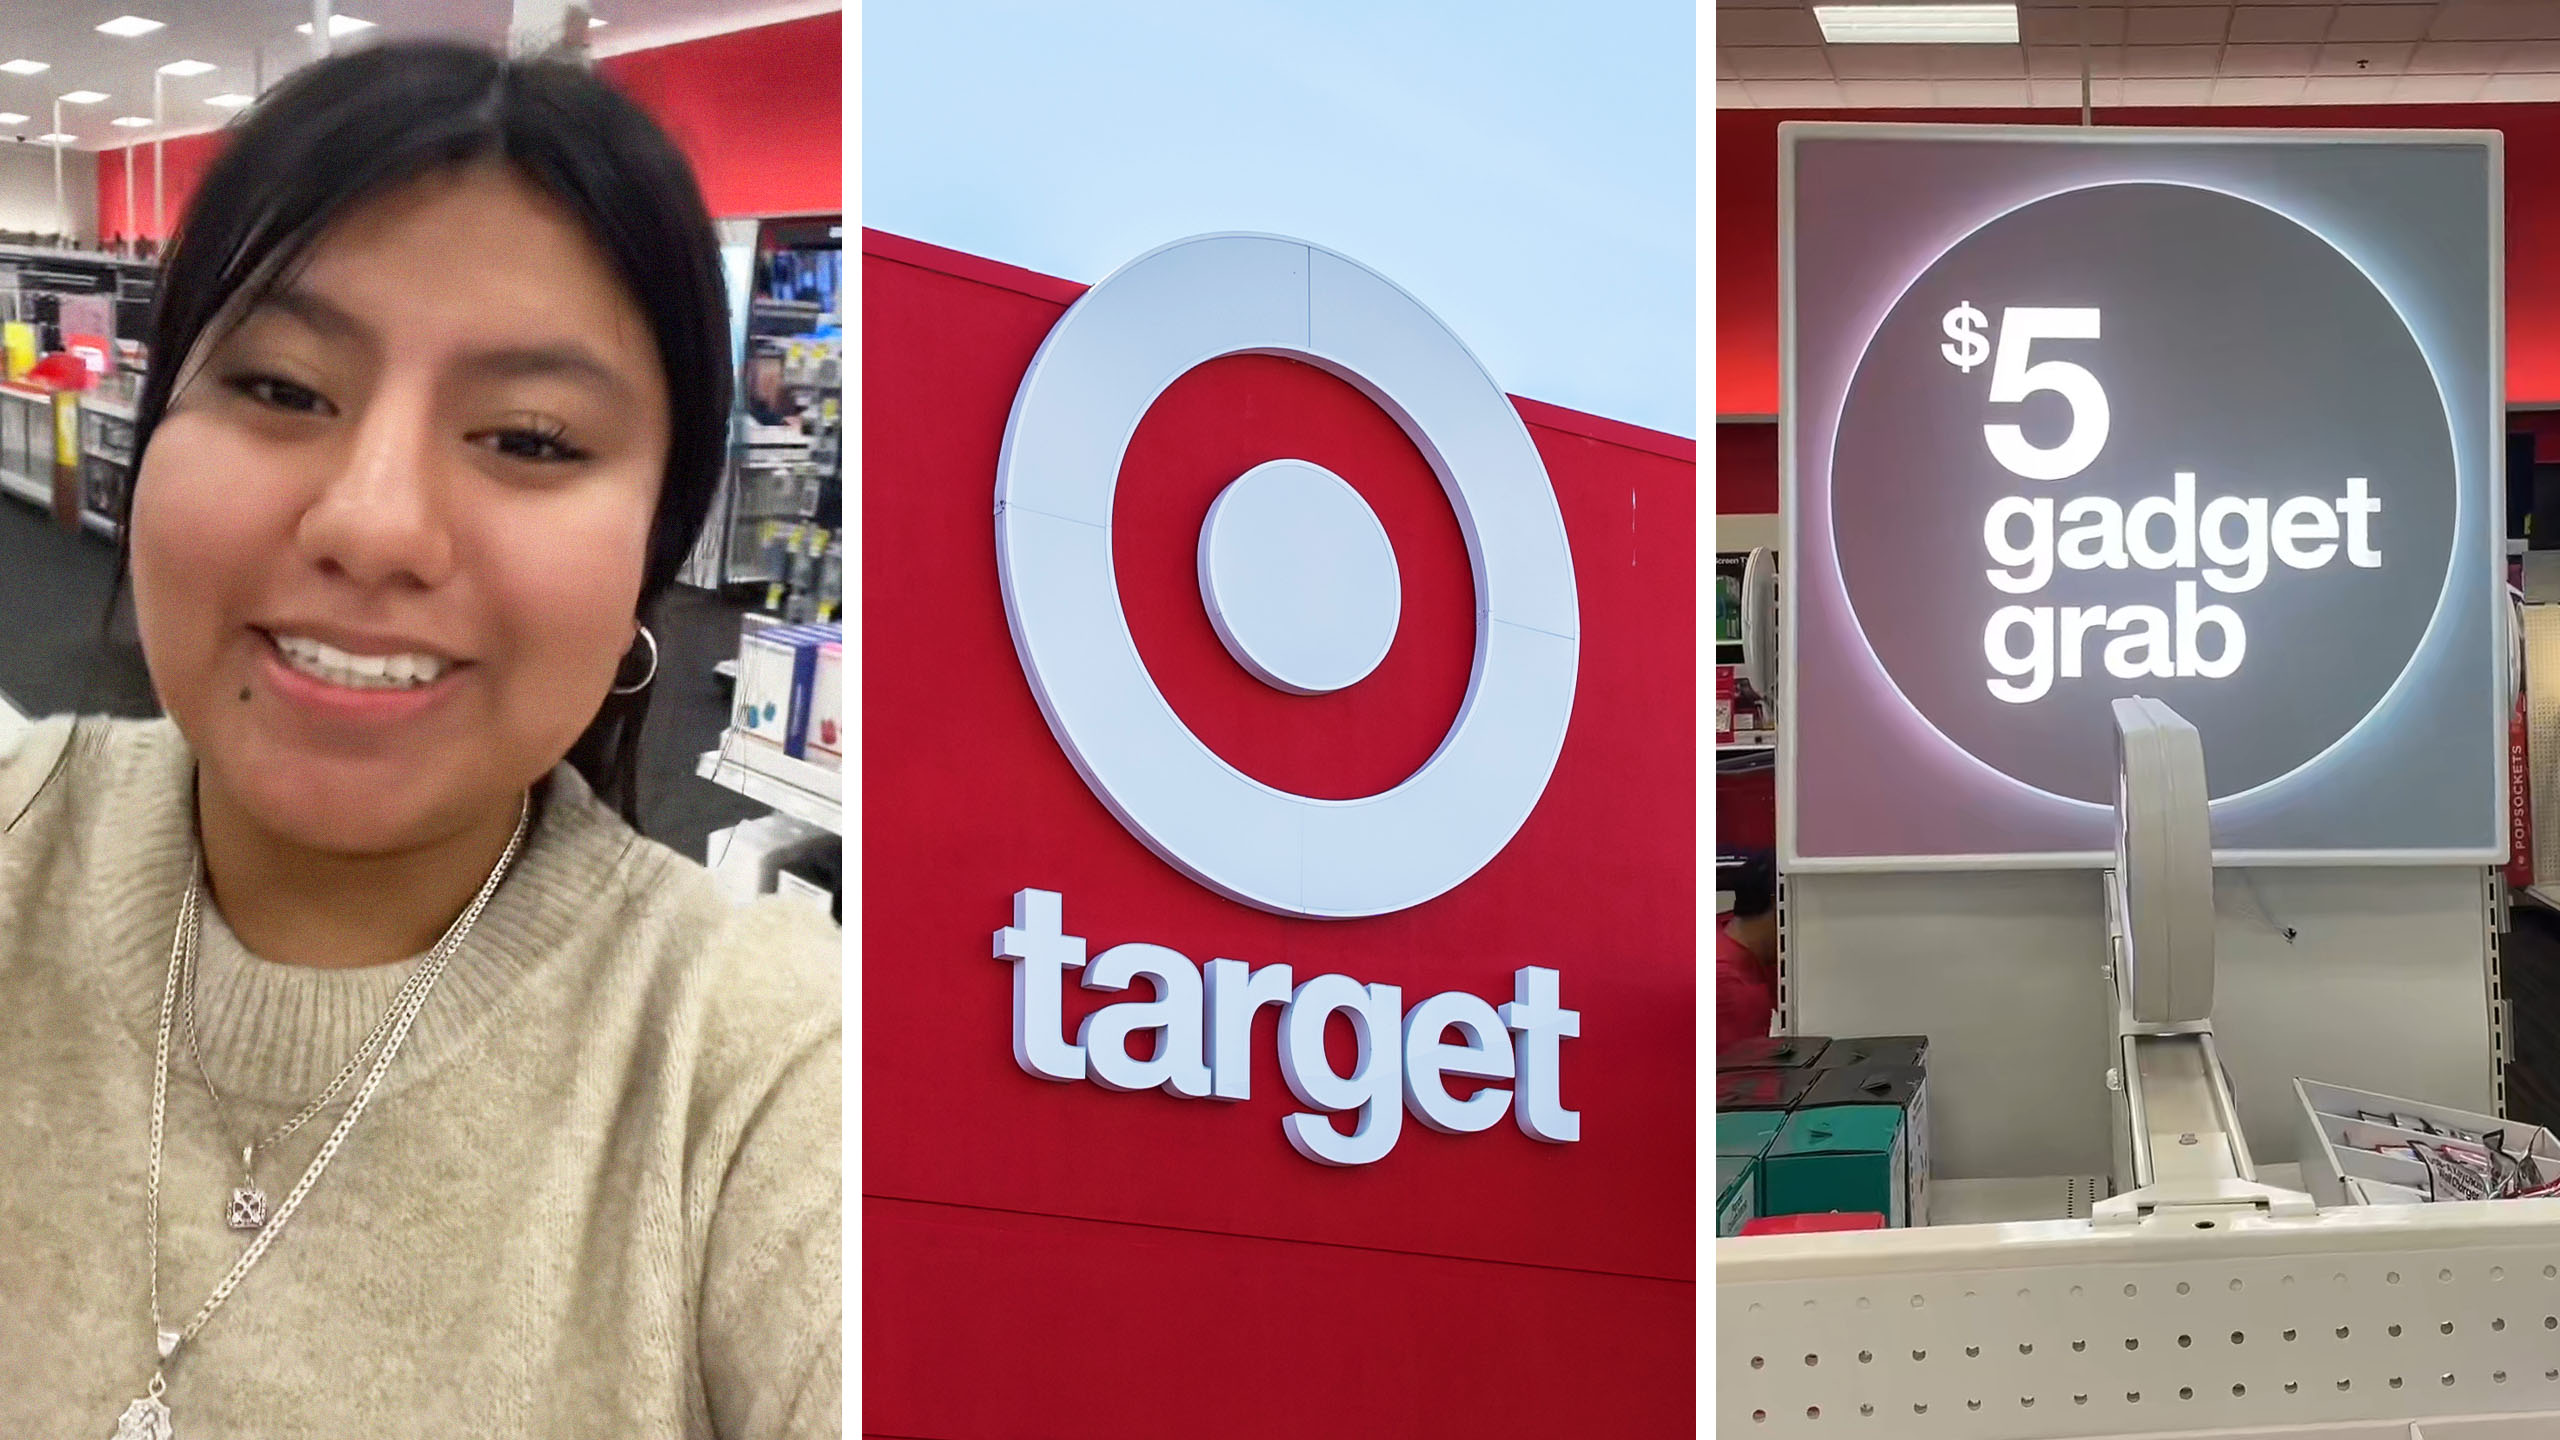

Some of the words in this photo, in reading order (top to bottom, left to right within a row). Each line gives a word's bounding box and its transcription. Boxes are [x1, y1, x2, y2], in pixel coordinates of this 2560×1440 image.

[1941, 301, 2110, 481] $5
[1984, 473, 2382, 593] gadget
[1984, 581, 2246, 703] grab
[2512, 744, 2526, 851] POPSOCKETS
[993, 888, 1580, 1166] target
